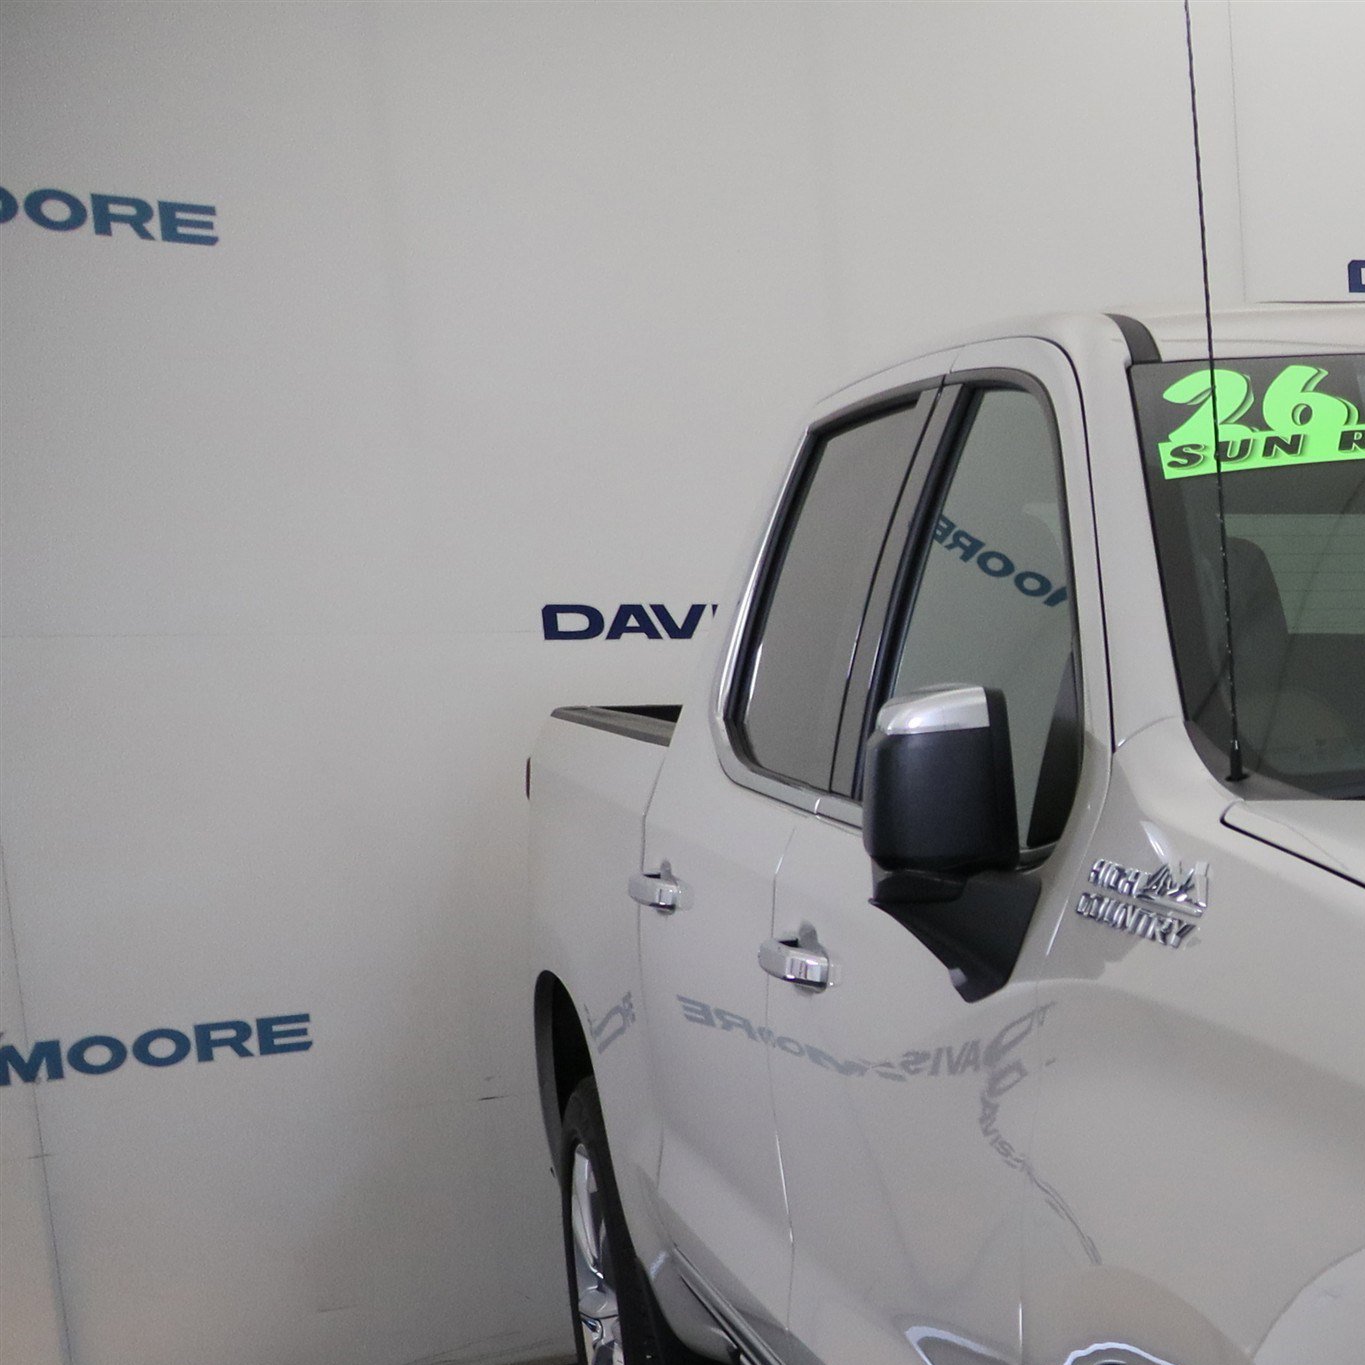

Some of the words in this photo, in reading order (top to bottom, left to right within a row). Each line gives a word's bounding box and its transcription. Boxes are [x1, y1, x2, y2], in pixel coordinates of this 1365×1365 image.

[0, 185, 219, 246] ORE
[1162, 364, 1359, 438] 26
[1167, 434, 1305, 470] SUN
[541, 604, 718, 640] DAV
[0, 1013, 313, 1086] MOORE
